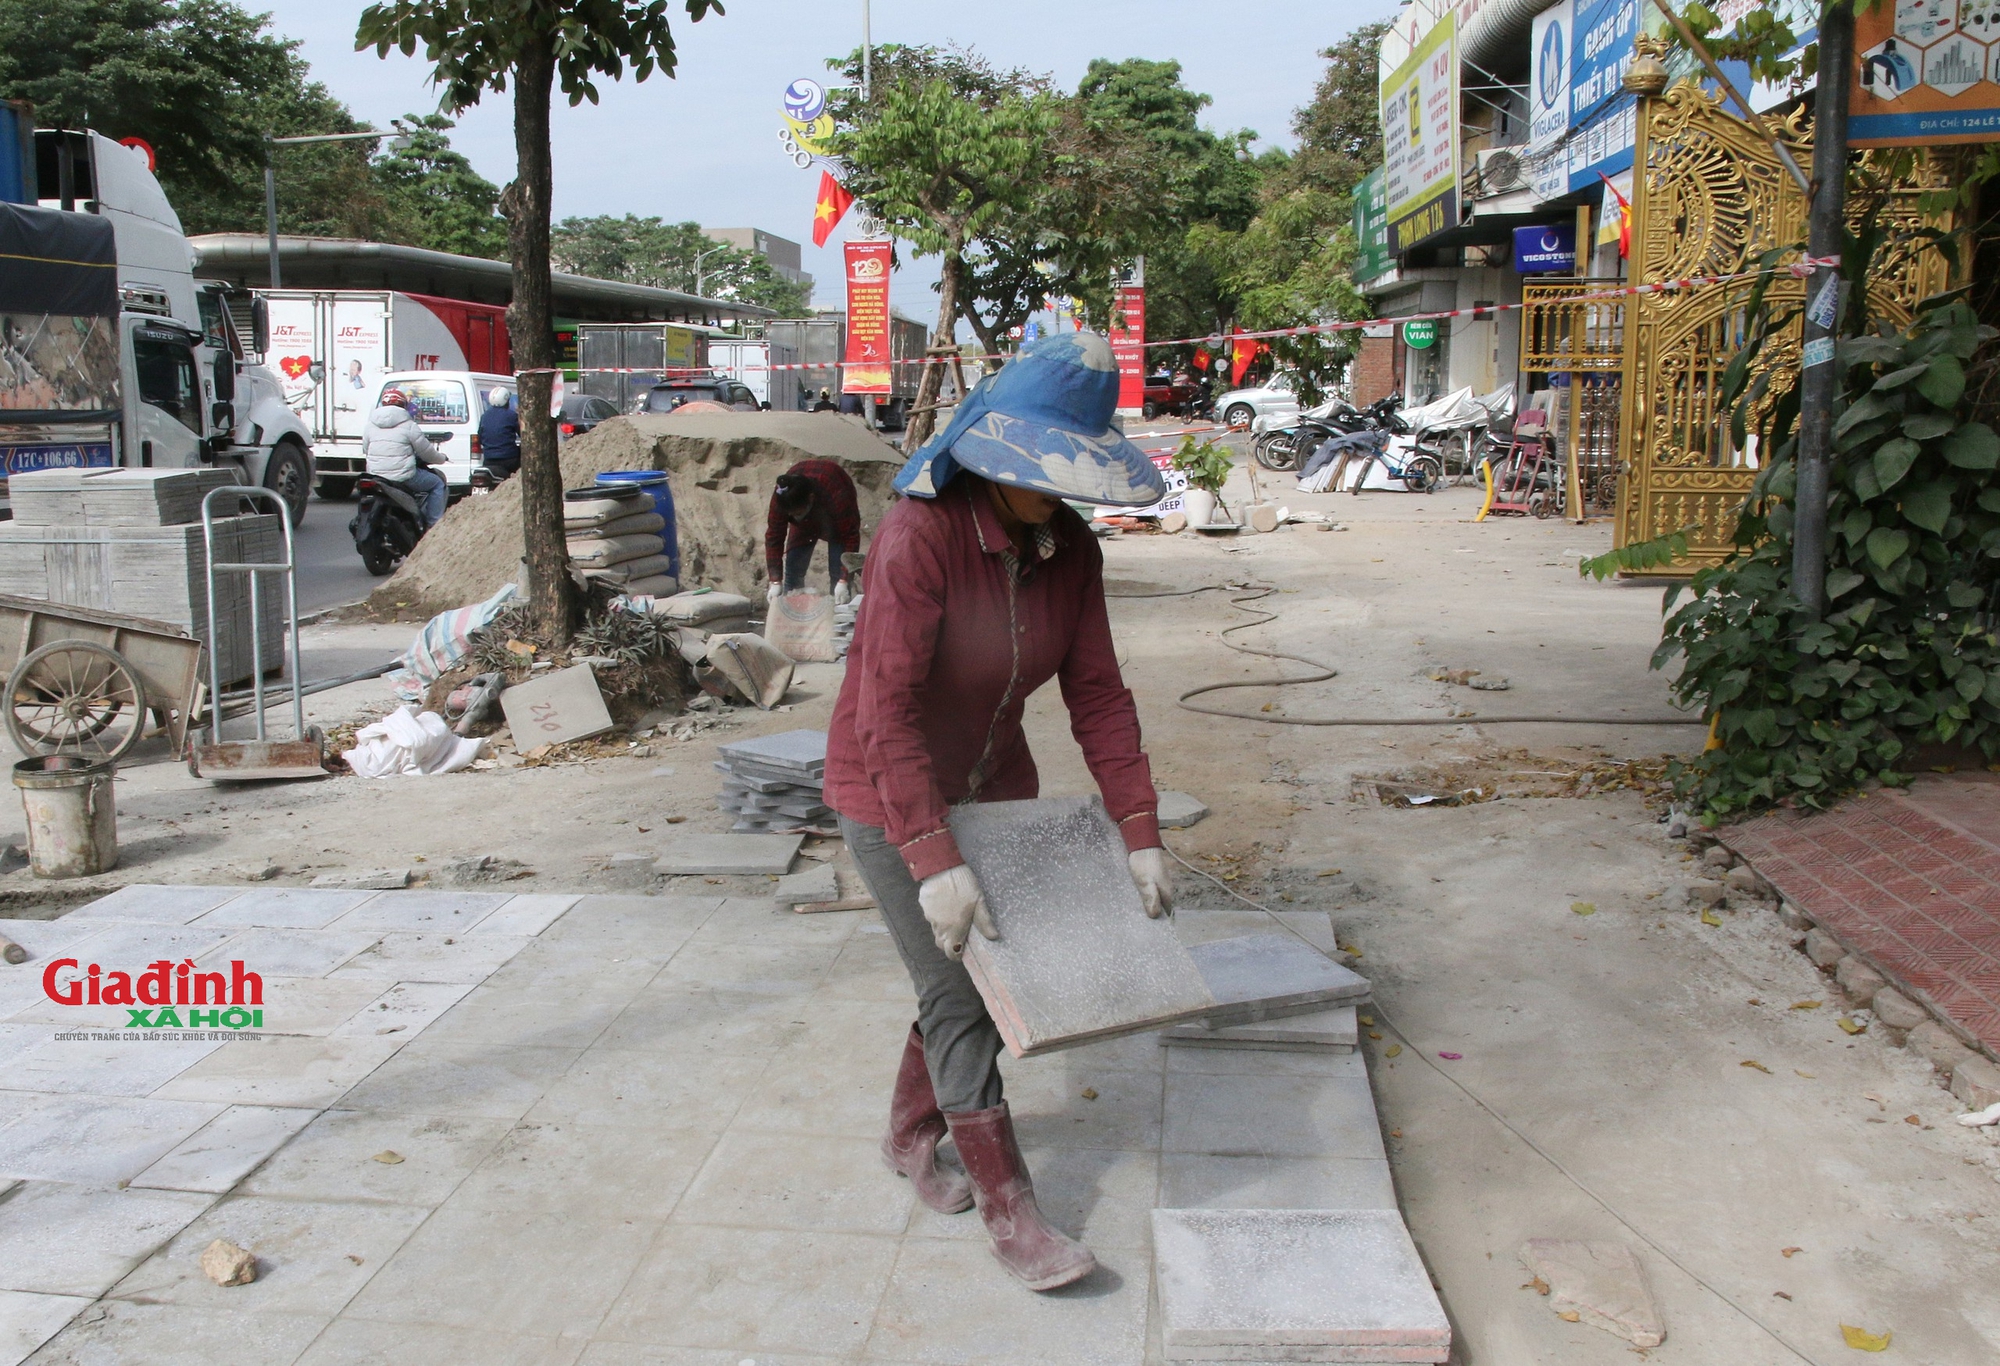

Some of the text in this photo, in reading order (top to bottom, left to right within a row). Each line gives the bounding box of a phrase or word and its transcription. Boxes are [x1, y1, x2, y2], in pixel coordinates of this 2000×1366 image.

[1584, 15, 1614, 62] GẠCH
[1573, 65, 1603, 114] THIẾT
[1534, 109, 1566, 138] VIGLACERA
[1963, 118, 1980, 127] 124
[146, 332, 174, 340] ISUZU
[272, 325, 297, 336] J&T
[337, 326, 363, 337] J&T
[1408, 331, 1434, 340] VIAN
